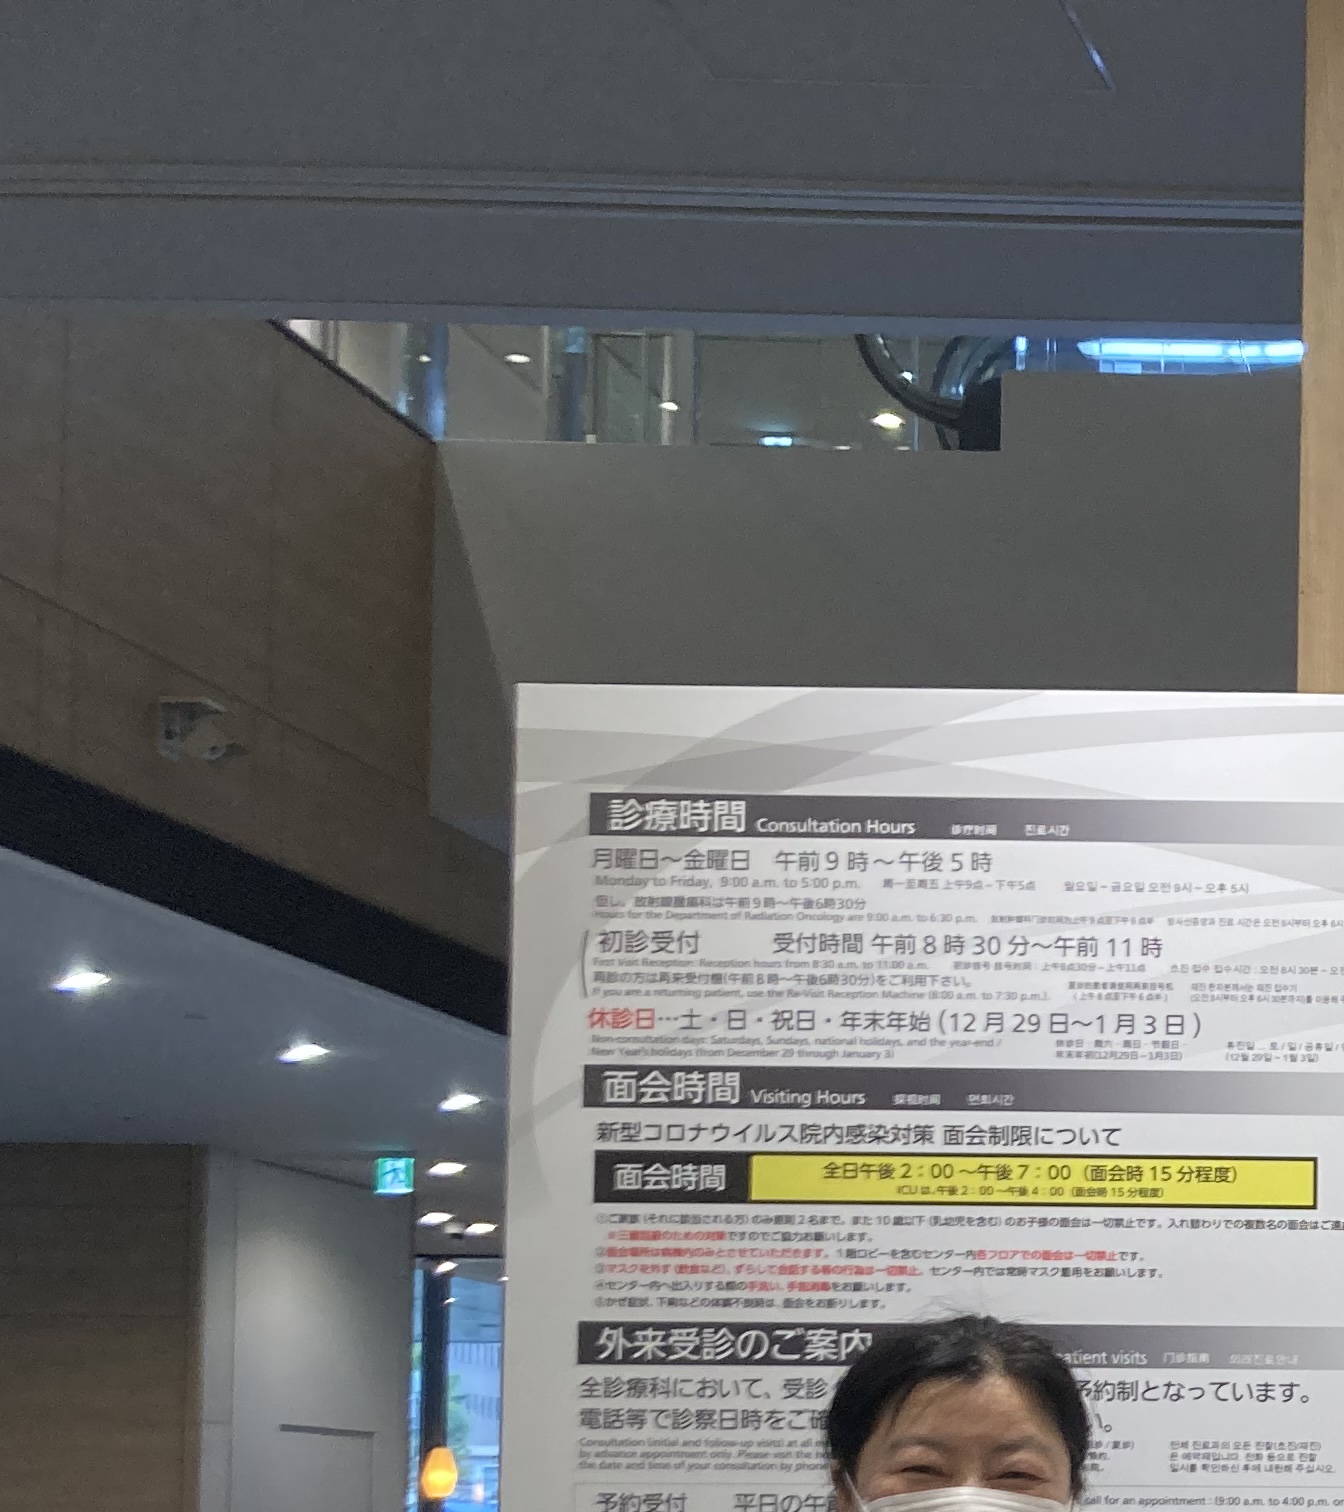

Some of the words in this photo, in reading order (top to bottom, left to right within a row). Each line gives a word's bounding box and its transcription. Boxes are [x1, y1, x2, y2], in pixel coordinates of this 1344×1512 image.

[607, 799, 747, 834] 診療時間
[755, 818, 861, 835] Consultation
[866, 819, 918, 836] Hours
[595, 875, 649, 889] Monday
[652, 877, 667, 888] to
[671, 875, 713, 890] Friday,
[720, 876, 749, 889] 9:00
[751, 878, 779, 889] a.m.
[783, 877, 798, 889] to
[801, 877, 829, 890] 5:00
[832, 879, 862, 892] p.m.
[597, 930, 700, 955] 初診受付
[772, 932, 864, 956] 受付時間
[603, 1069, 741, 1106] 面会時間
[749, 1089, 813, 1108] Visiting
[816, 1089, 866, 1105] Hours
[595, 1121, 935, 1146] 新型コロナウイルス院内感染対策
[943, 1124, 1123, 1148] 面会制限について
[613, 1162, 728, 1192] 面会時間
[596, 1325, 873, 1362] 外来受診のご案内
[1111, 1350, 1148, 1366] visits
[1139, 1495, 1206, 1508] appointment
